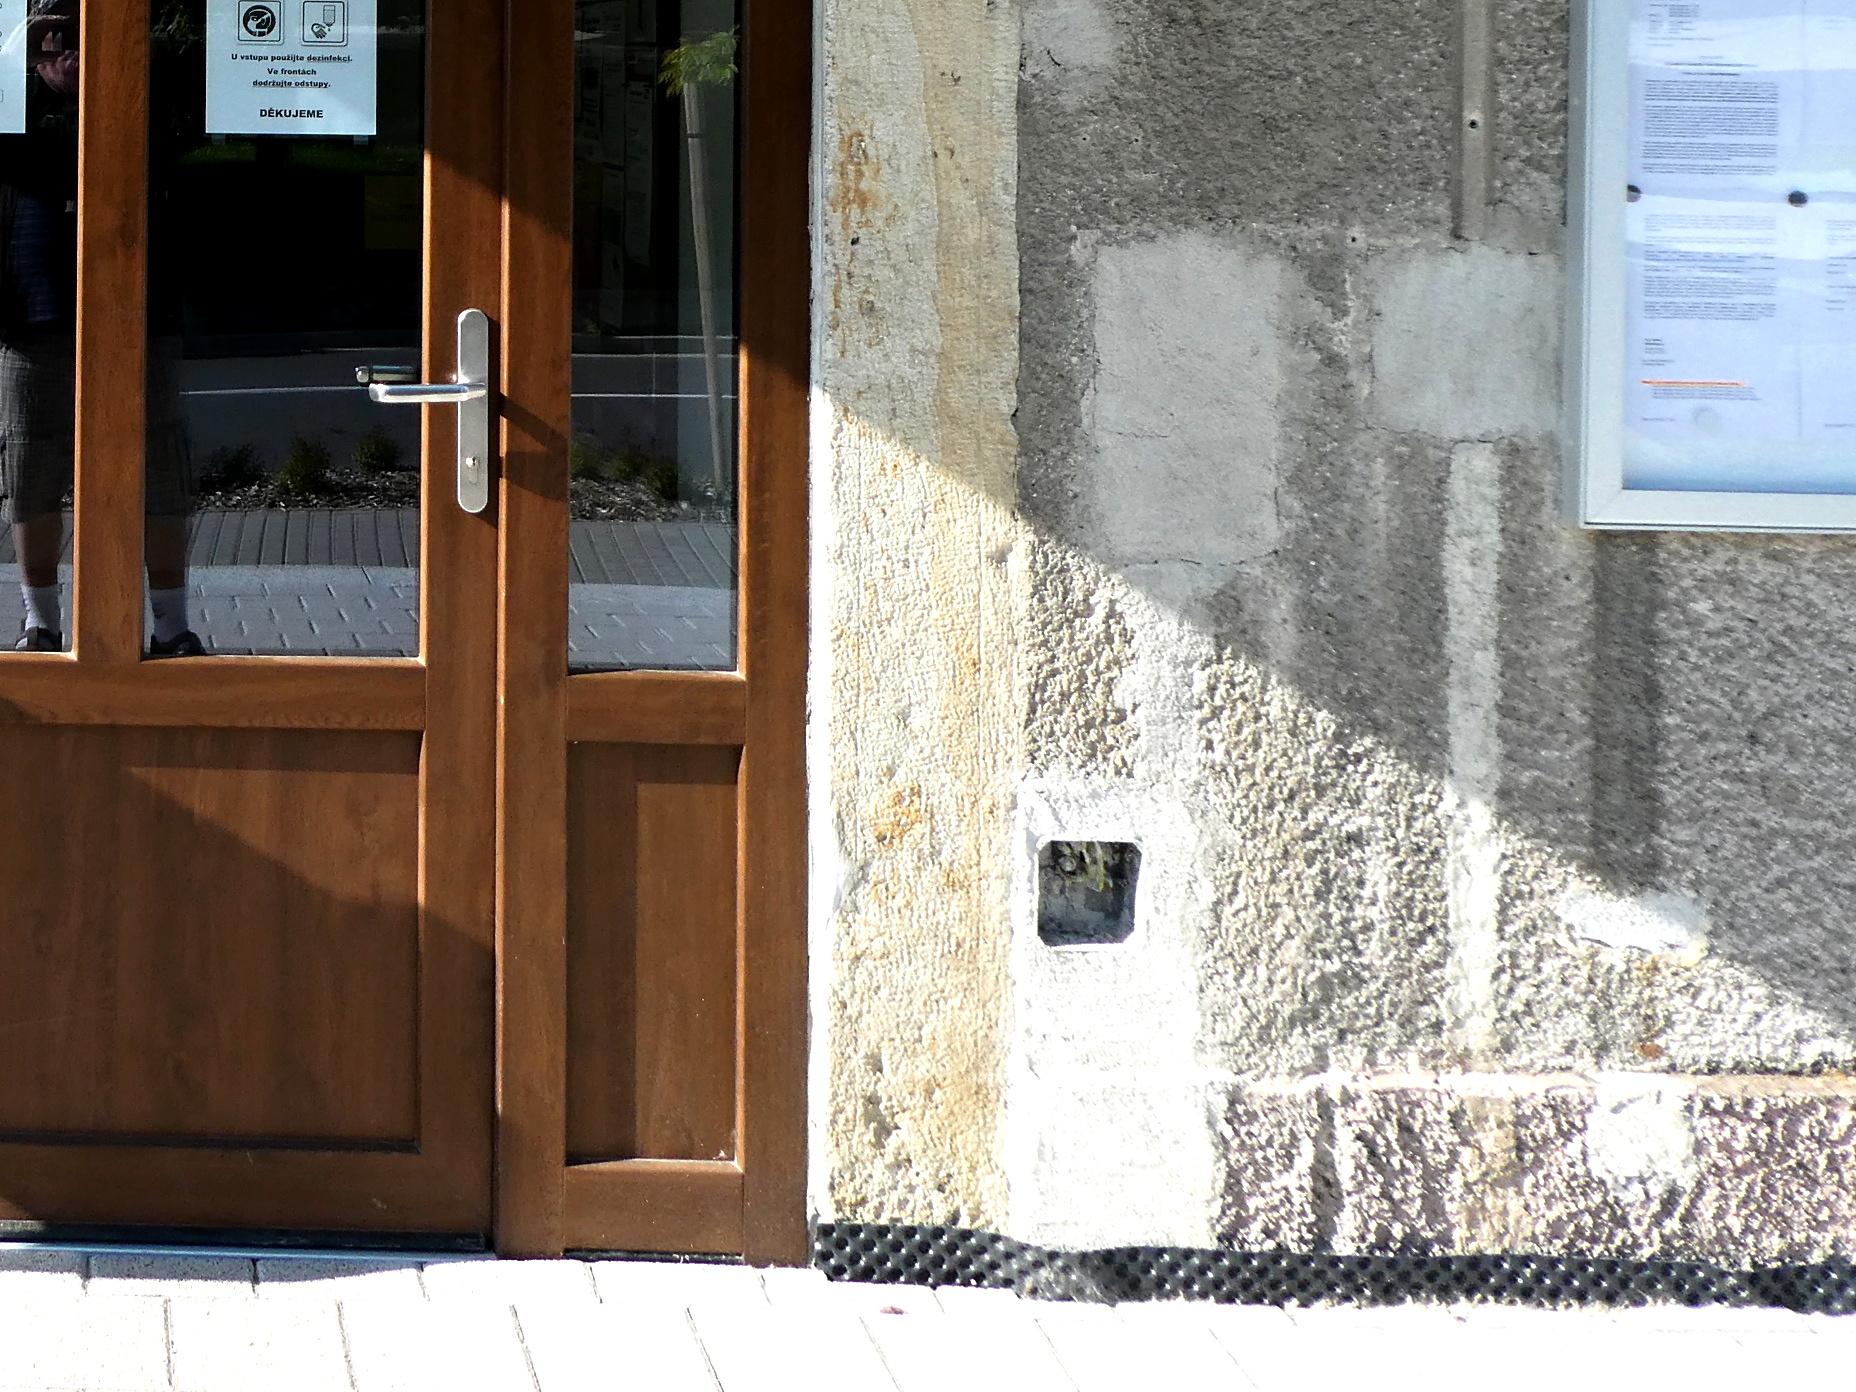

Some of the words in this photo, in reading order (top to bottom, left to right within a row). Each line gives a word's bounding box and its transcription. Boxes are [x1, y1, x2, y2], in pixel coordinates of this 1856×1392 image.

[240, 54, 269, 62] vstupu
[271, 54, 304, 63] použijte
[281, 68, 317, 76] frontách
[252, 79, 292, 88] dodržujte
[294, 80, 331, 89] odstupy.
[259, 108, 324, 118] DĚKUJEME
